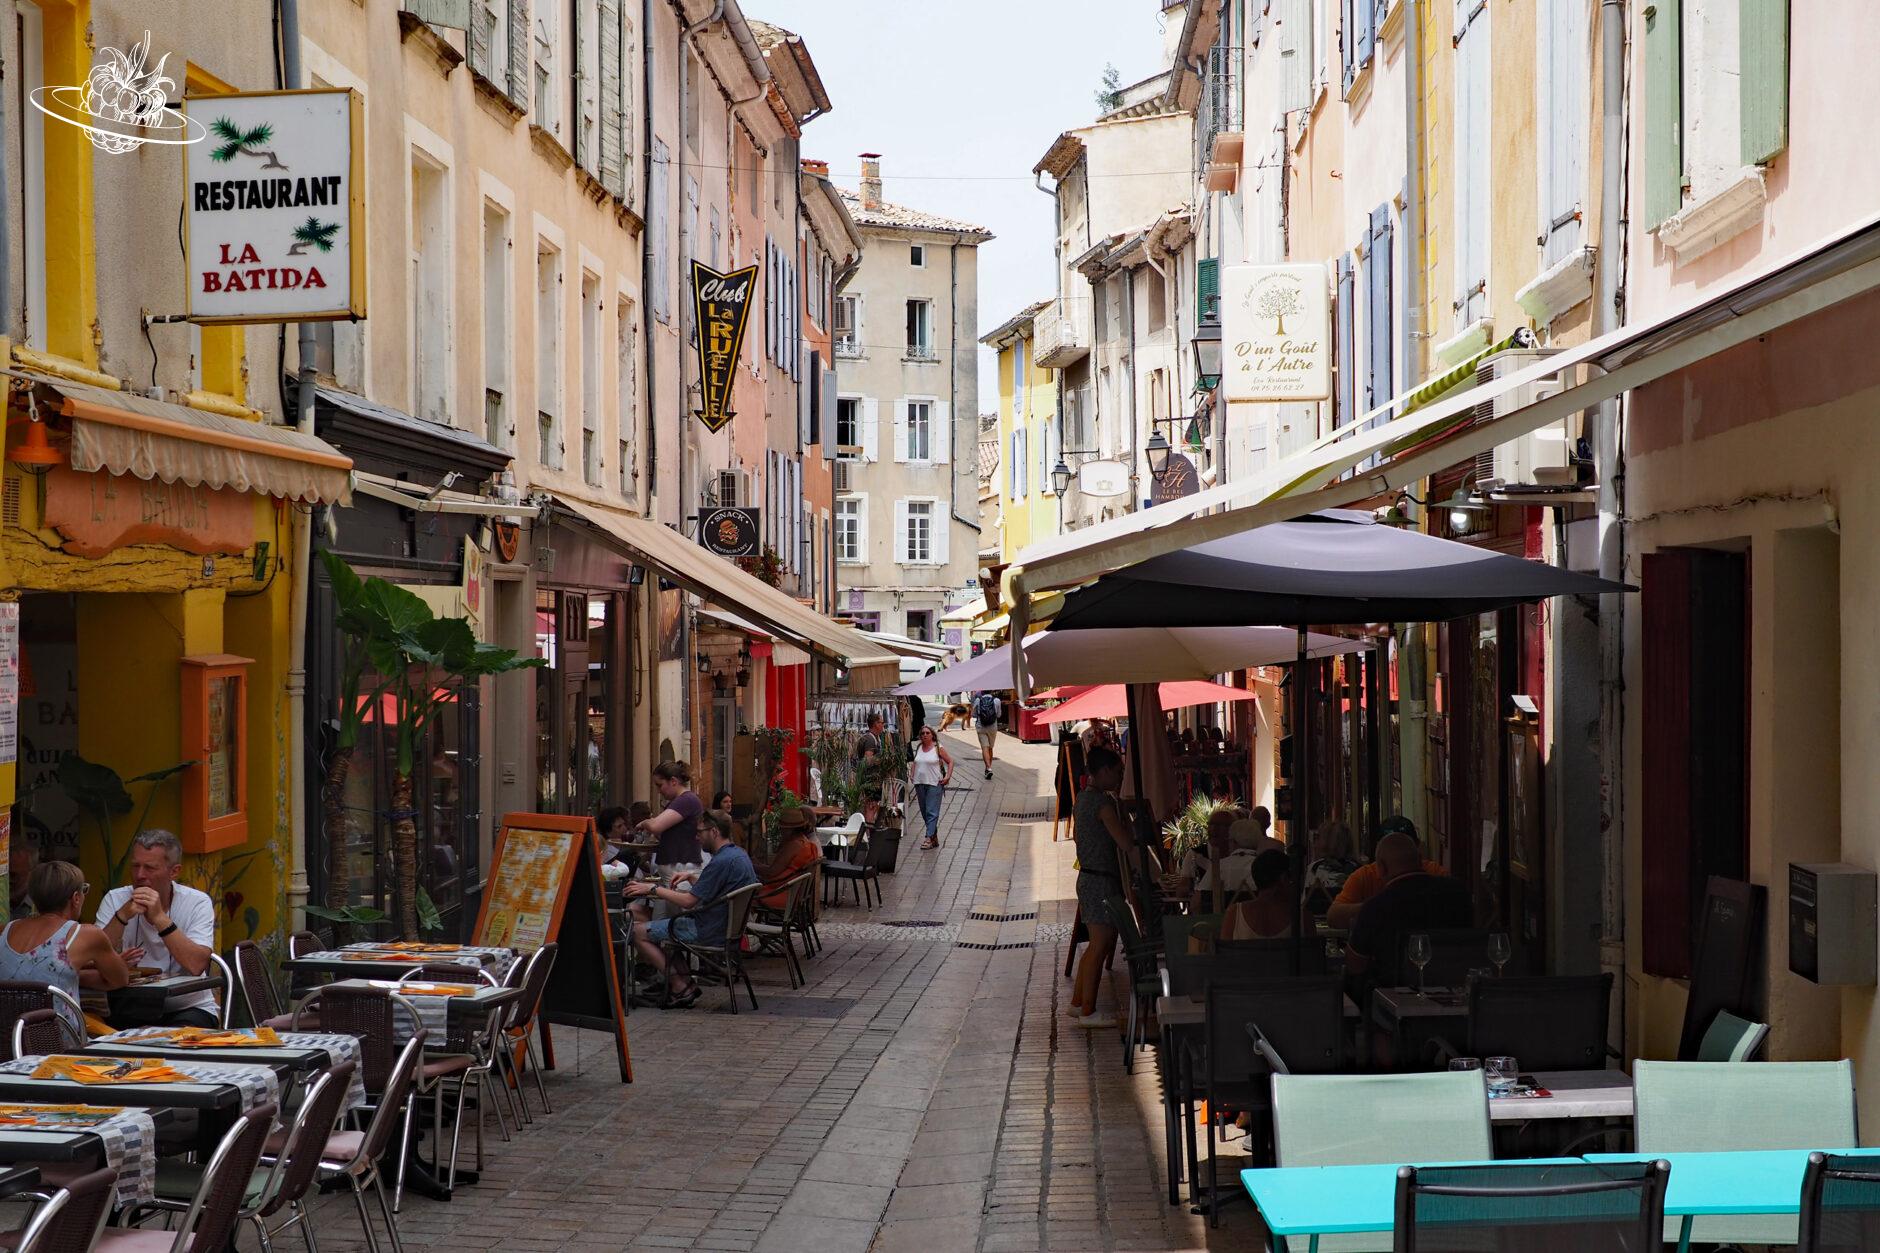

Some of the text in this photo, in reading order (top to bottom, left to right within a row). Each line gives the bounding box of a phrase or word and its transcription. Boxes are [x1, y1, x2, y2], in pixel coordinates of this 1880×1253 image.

[194, 176, 342, 212] RESTAURANT
[219, 243, 262, 265] LA
[202, 266, 327, 293] BATIDA
[700, 278, 748, 303] Club
[708, 303, 734, 320] La
[1234, 340, 1318, 357] D'un Goût
[708, 321, 735, 417] RUELLE
[1241, 360, 1252, 371] à
[714, 511, 746, 523] SNACK
